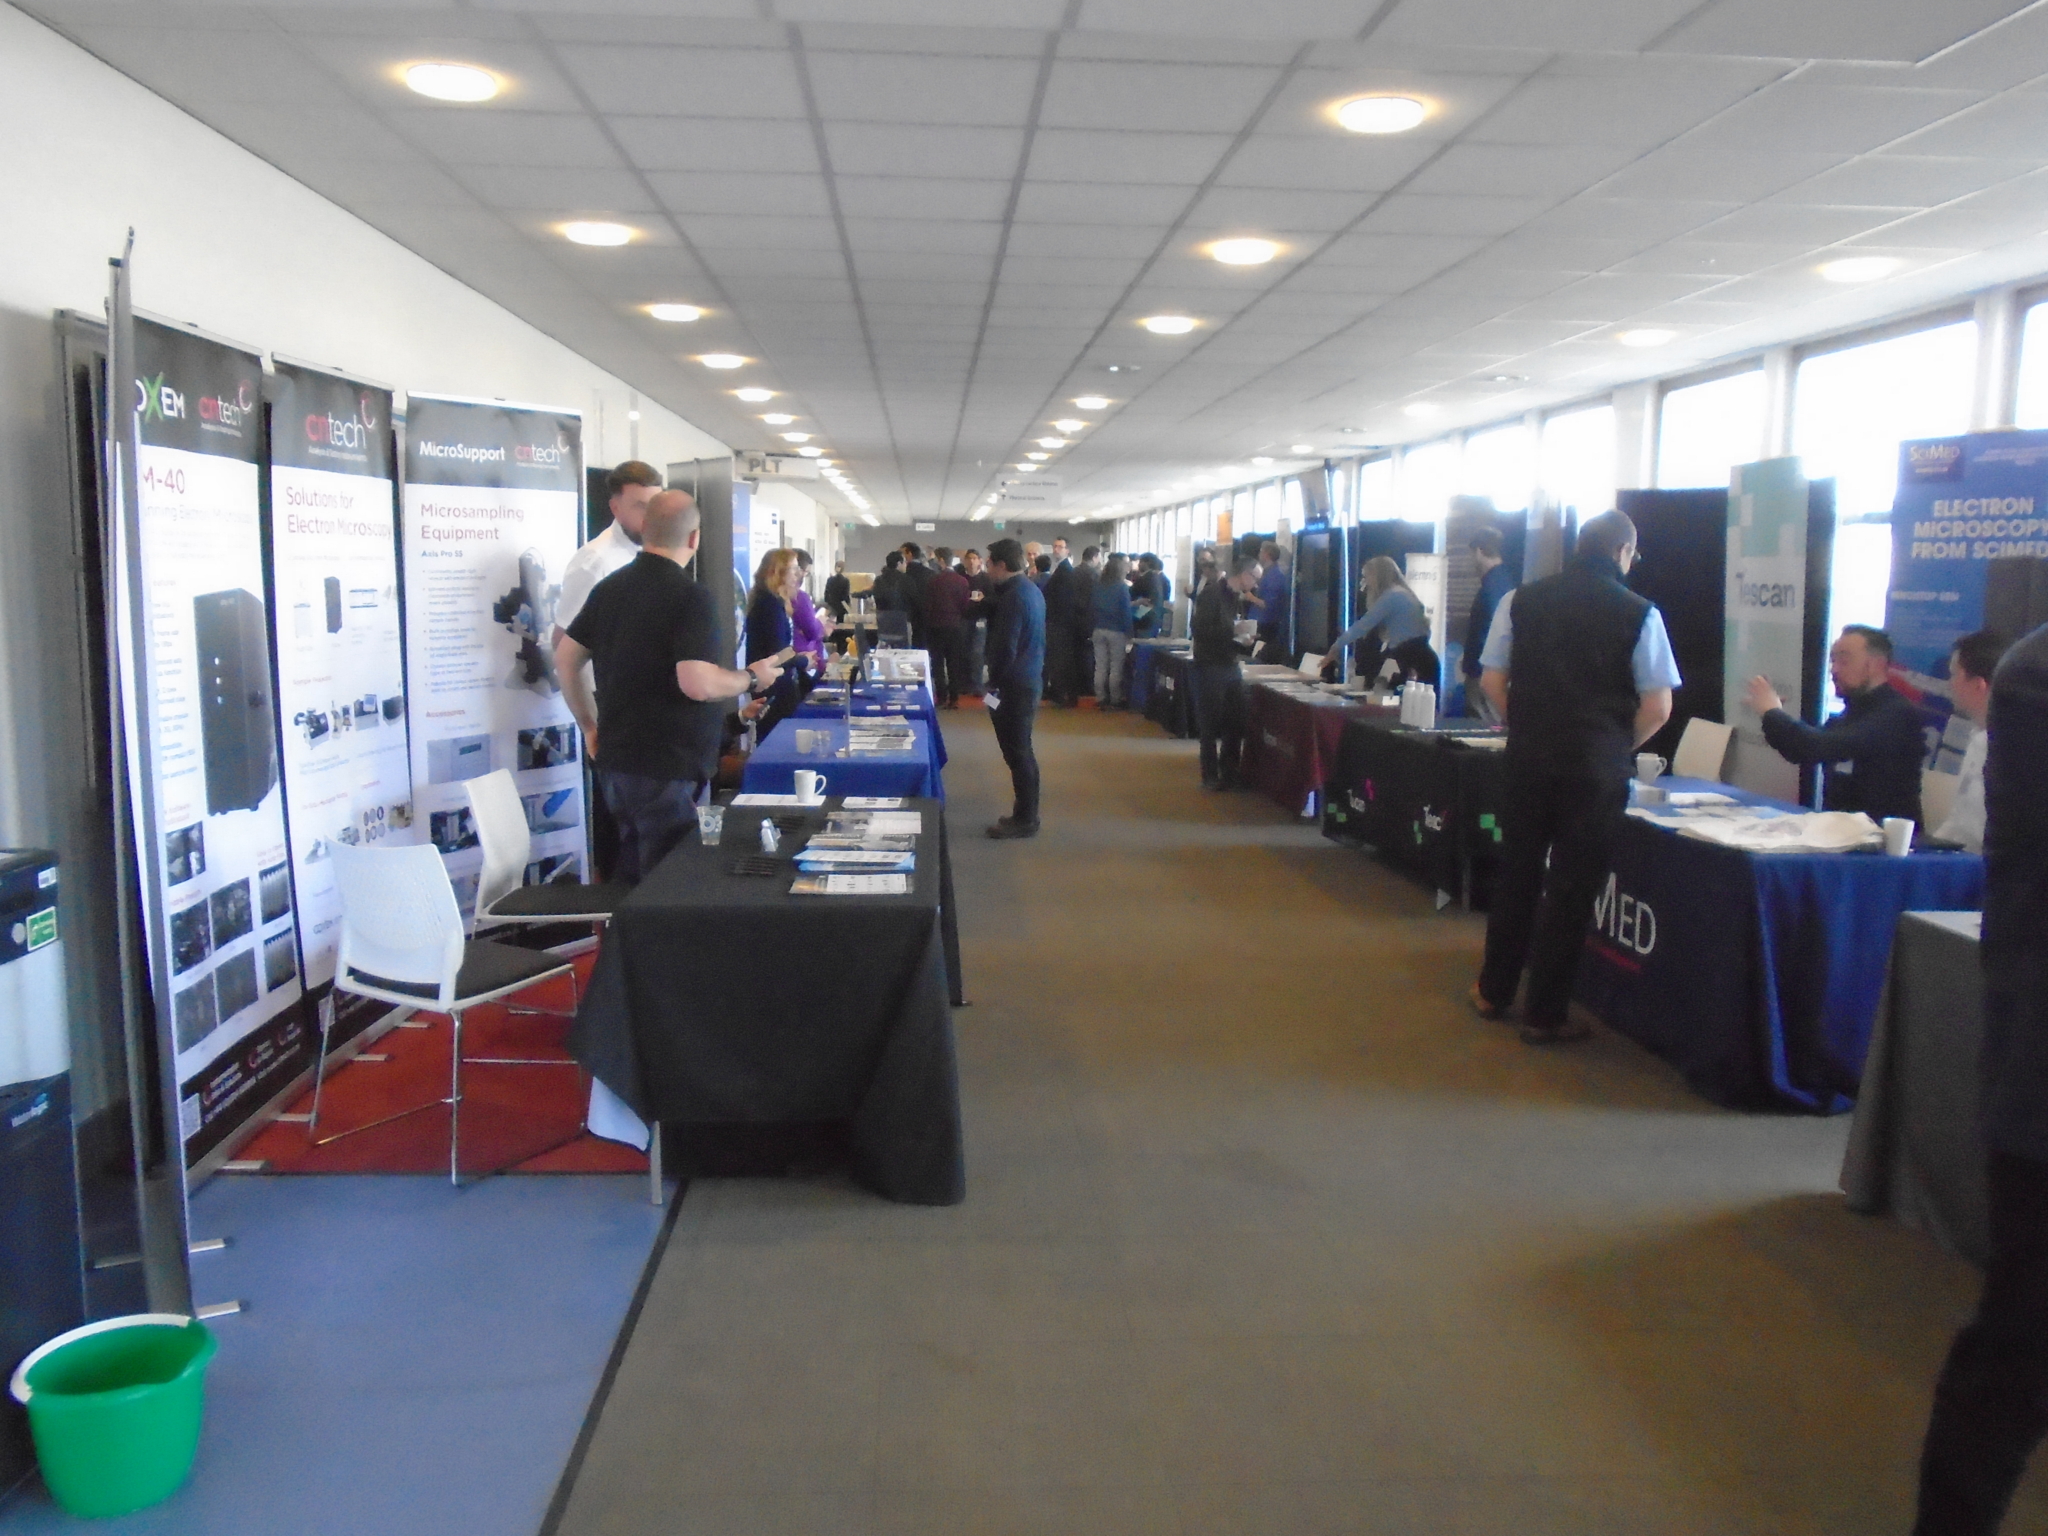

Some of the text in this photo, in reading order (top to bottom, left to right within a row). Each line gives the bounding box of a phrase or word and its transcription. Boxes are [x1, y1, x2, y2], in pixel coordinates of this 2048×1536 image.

[419, 440, 506, 463] MicroSupport
[748, 458, 782, 474] PLT
[286, 486, 355, 509] Solutions for
[1933, 496, 2034, 518] ELECTRON
[420, 503, 525, 524] Microsampling
[287, 514, 392, 541] Electron Microscopy
[420, 525, 500, 543] Equipment
[1914, 518, 2048, 538] MICROSCOPY
[1911, 541, 1967, 559] FROM
[1736, 571, 1796, 609] Tescan
